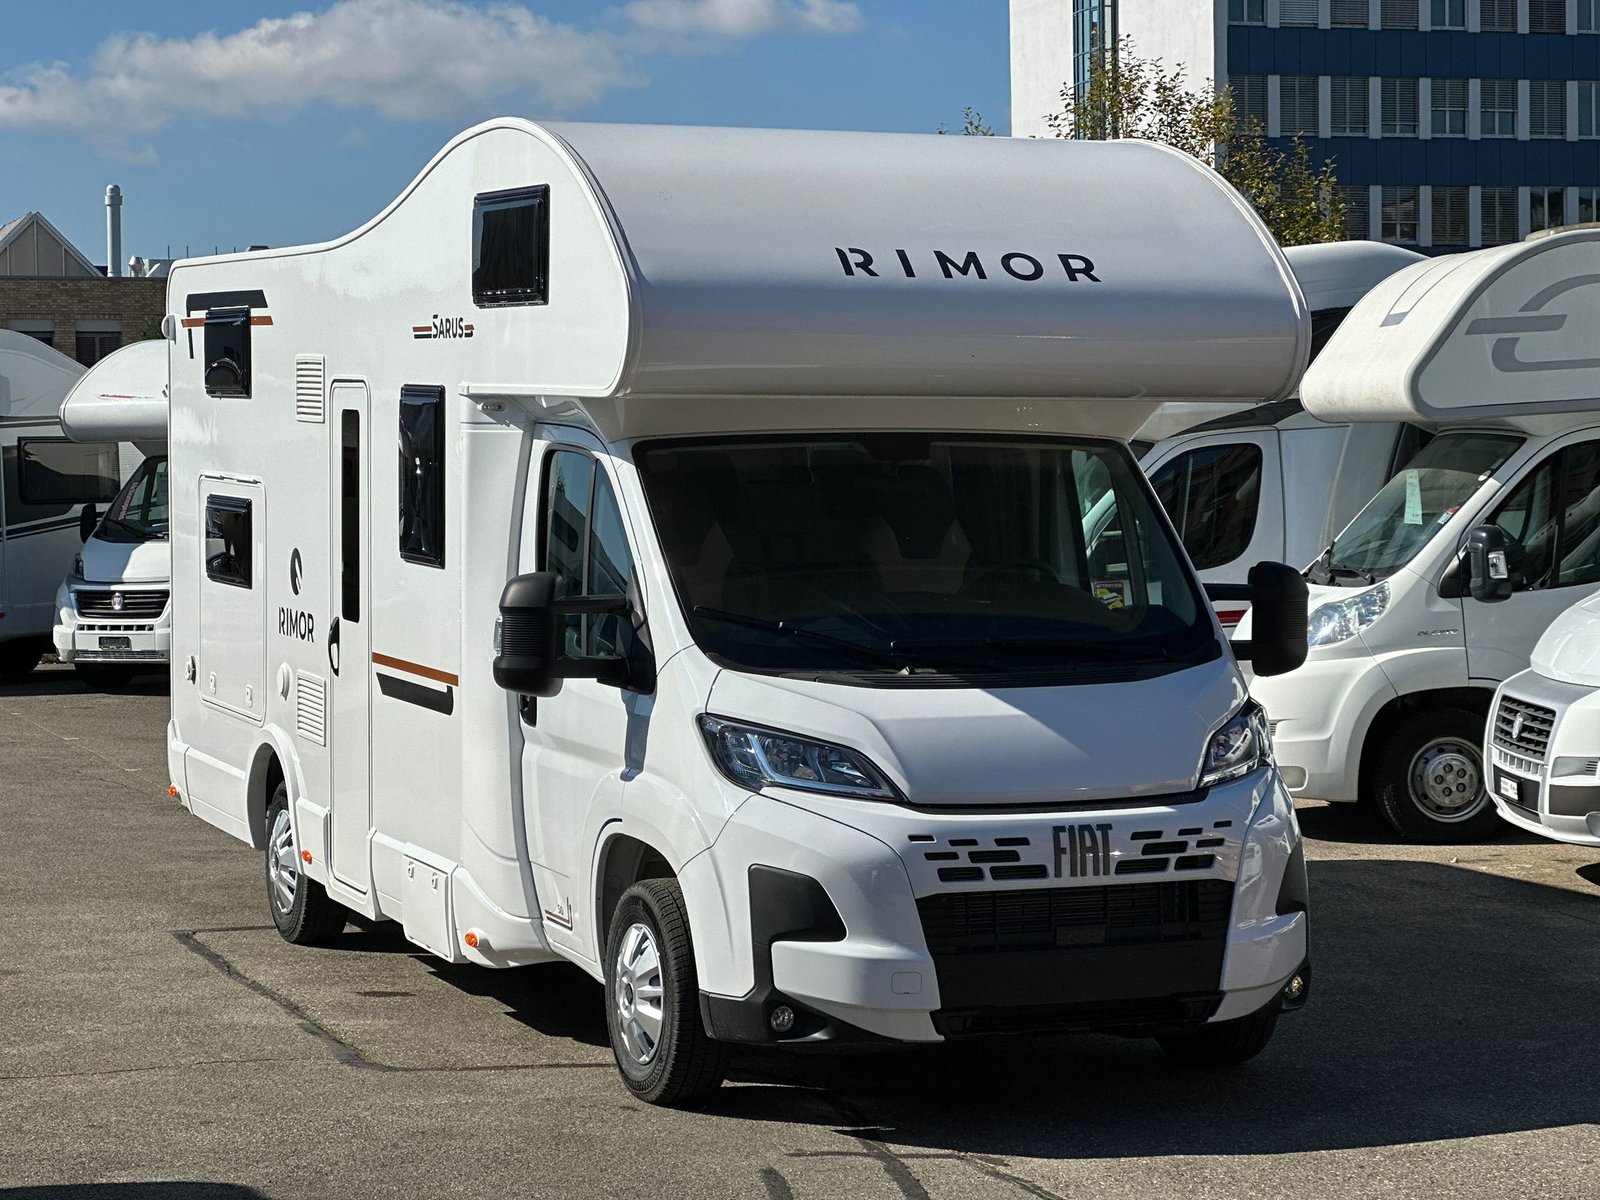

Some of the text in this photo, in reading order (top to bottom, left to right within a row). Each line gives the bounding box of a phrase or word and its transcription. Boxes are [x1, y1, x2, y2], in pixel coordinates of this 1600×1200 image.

[834, 247, 1102, 283] RIMOR
[432, 314, 464, 339] SARUS
[278, 606, 315, 643] RIMOR
[1052, 823, 1113, 878] FIAT
